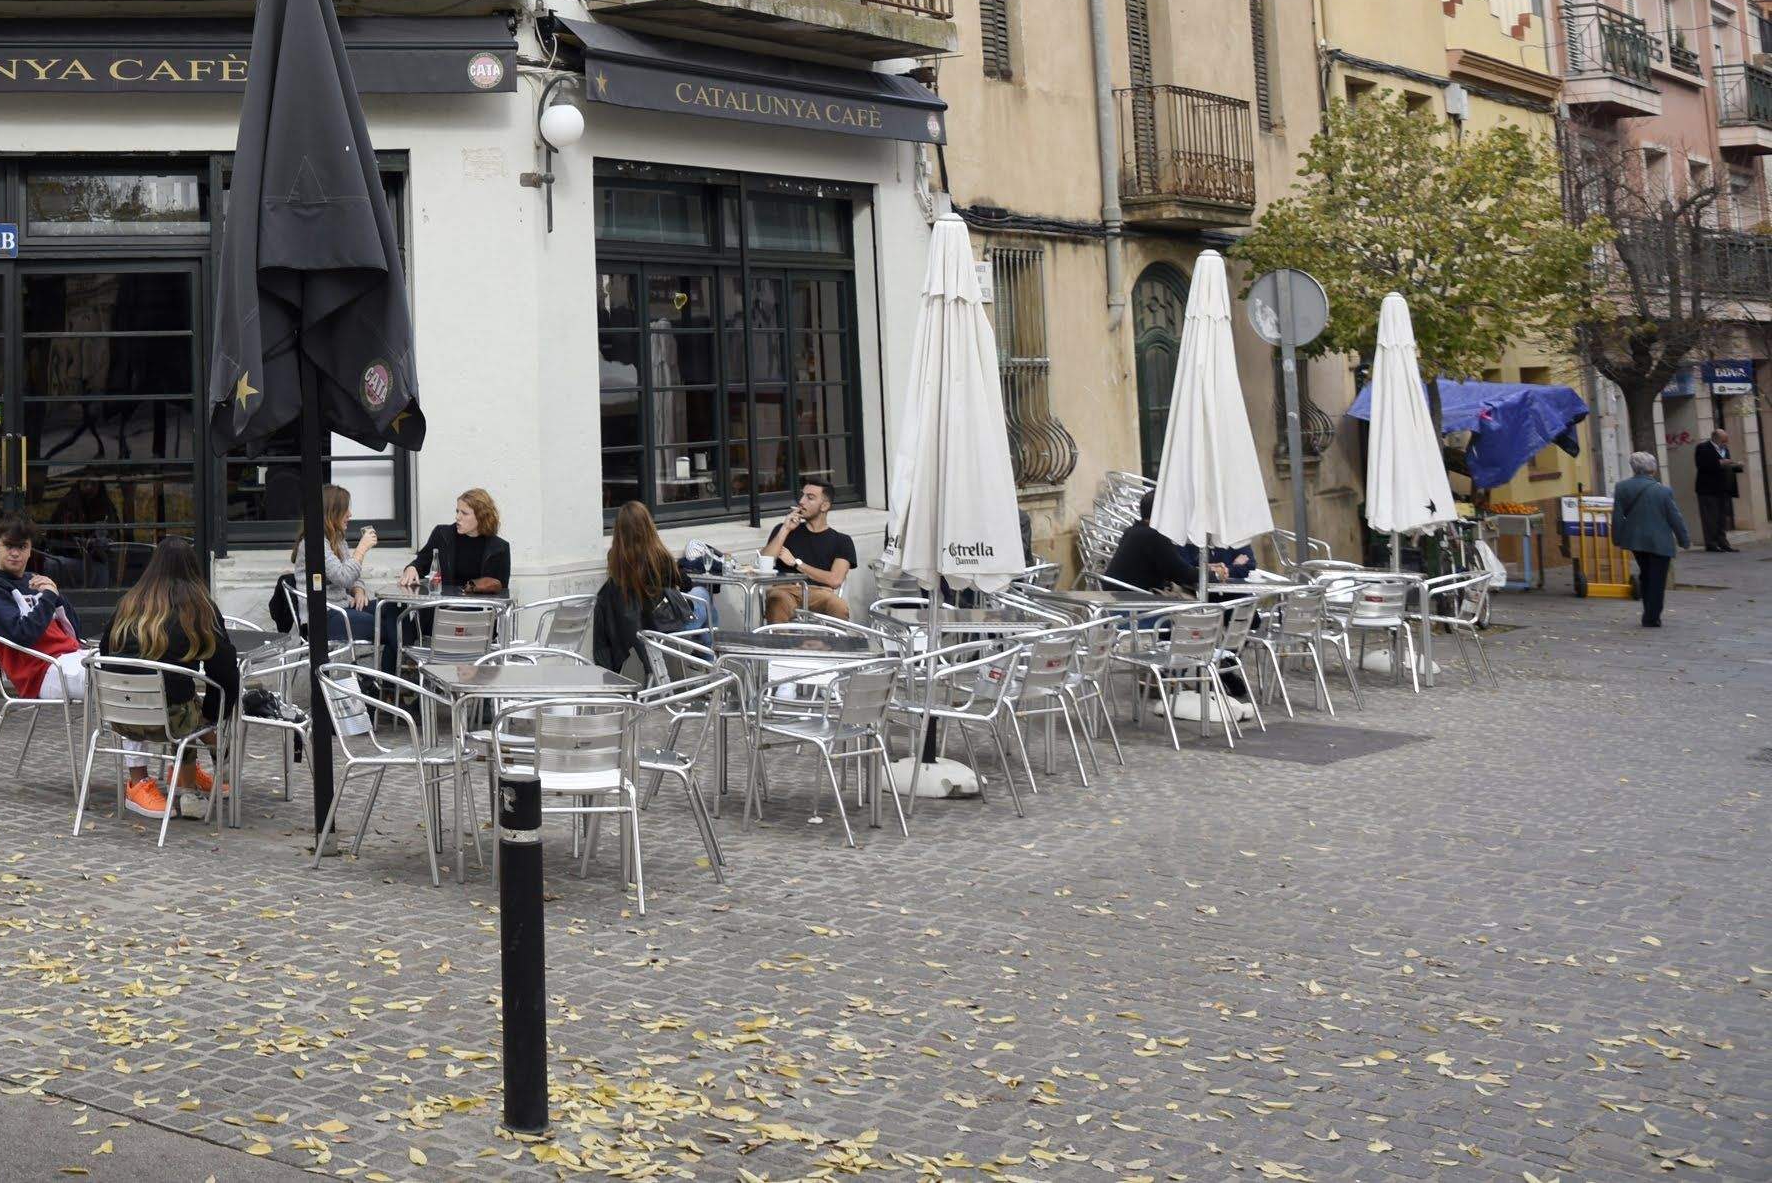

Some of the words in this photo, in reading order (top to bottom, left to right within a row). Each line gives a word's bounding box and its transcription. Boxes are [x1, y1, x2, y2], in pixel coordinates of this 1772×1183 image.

[108, 54, 248, 81] CAFÈ
[470, 64, 501, 77] CATA
[675, 82, 821, 121] CATALUNYA
[825, 104, 884, 129] CAFÈ
[364, 367, 388, 403] CATA
[949, 542, 994, 557] Estrella
[955, 557, 979, 566] Damm
